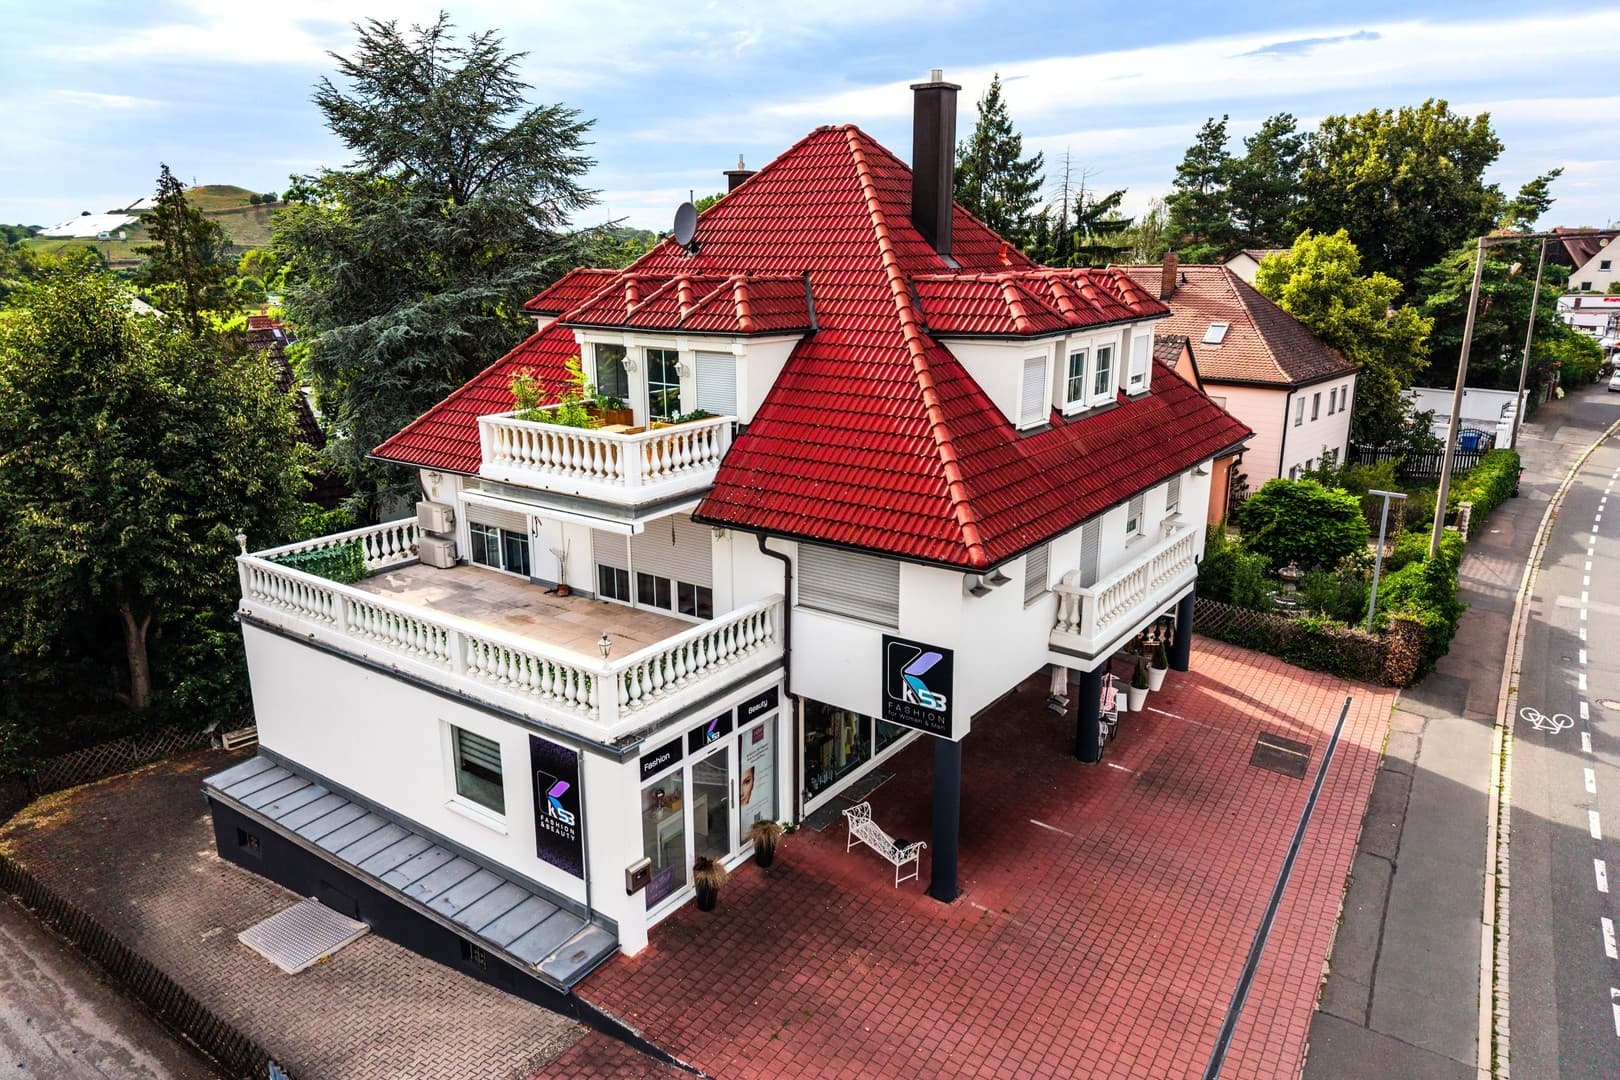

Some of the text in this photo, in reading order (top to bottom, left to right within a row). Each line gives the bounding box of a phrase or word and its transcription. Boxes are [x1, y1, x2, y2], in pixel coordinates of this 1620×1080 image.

[748, 699, 768, 715] Beauty
[888, 701, 945, 724] FASHION
[900, 714, 922, 724] Women
[643, 752, 671, 772] Fashion
[540, 814, 575, 835] FASHION
